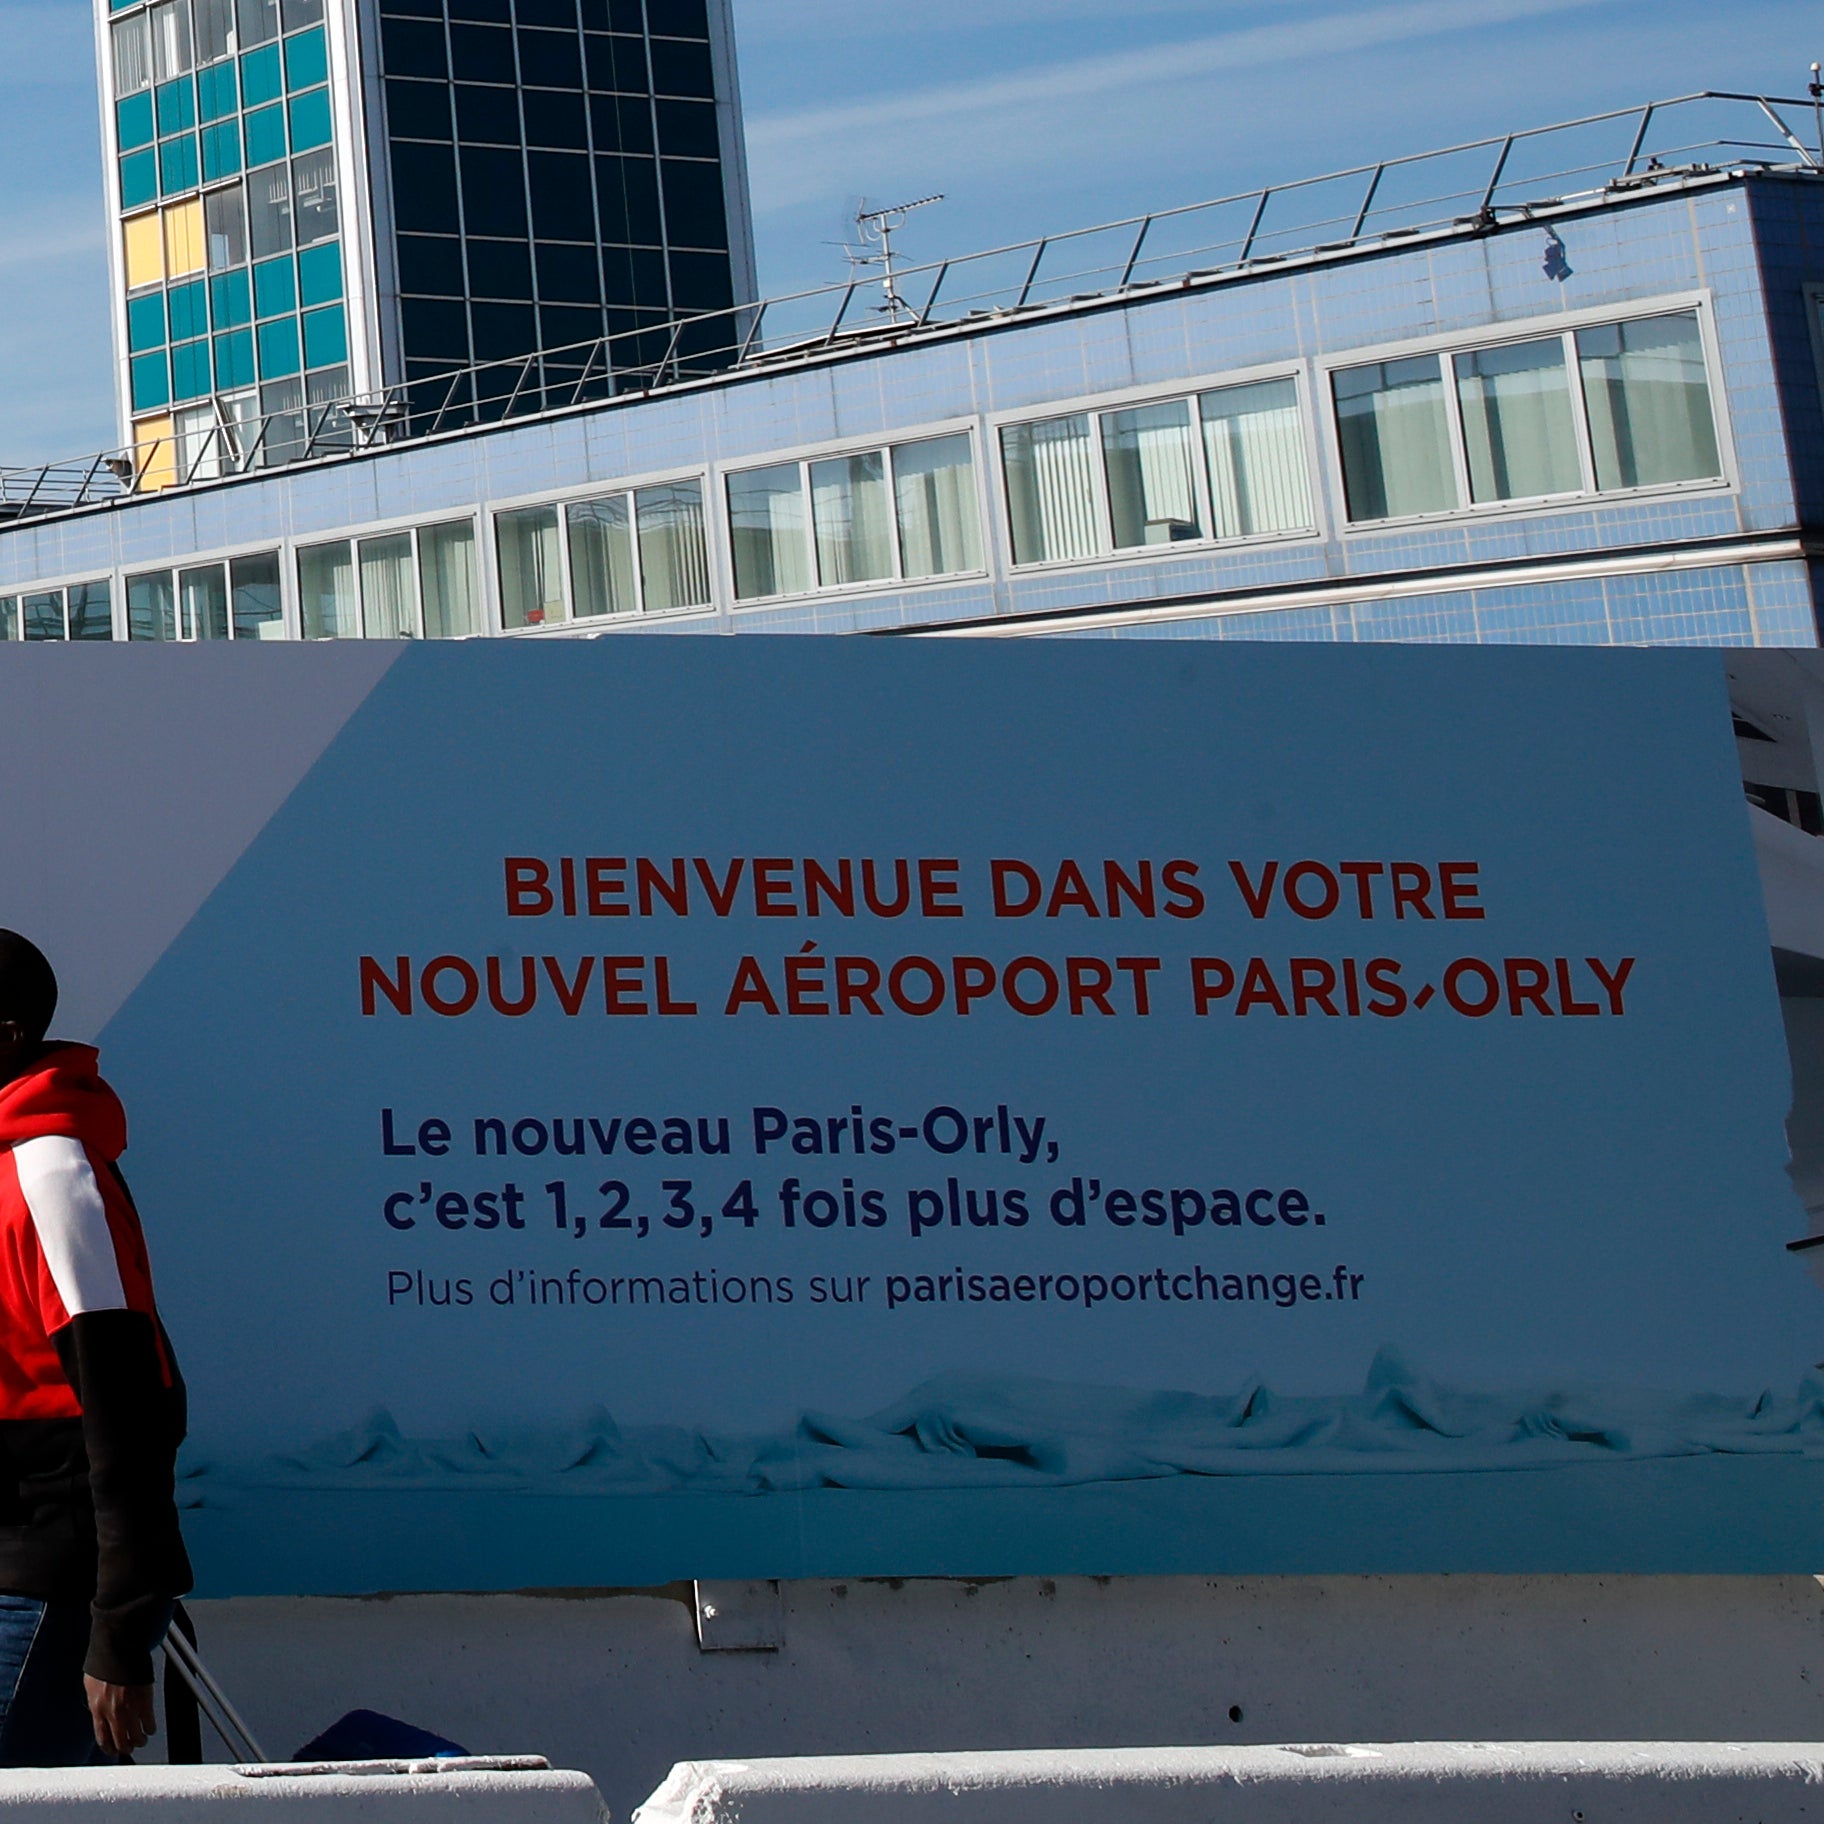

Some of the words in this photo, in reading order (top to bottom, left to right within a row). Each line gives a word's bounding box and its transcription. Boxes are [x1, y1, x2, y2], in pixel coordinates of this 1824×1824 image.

[505, 857, 964, 918] BIENVENUE
[991, 859, 1205, 919] DANS
[1229, 860, 1485, 920] VOTRE
[360, 955, 698, 1017] NOUVEL
[726, 941, 1161, 1017] AÉROPORT
[381, 1107, 452, 1157] Le
[473, 1117, 731, 1156] nouveau
[752, 1104, 1059, 1164] Paris-Orly,
[383, 1181, 526, 1231] c’est
[778, 1177, 888, 1228] fois
[907, 1177, 1030, 1238] plus
[1049, 1176, 1326, 1237] d’espace.
[387, 1269, 474, 1306] Plus
[489, 1268, 794, 1306] d’informations
[809, 1276, 871, 1304] sur
[885, 1264, 1365, 1310] parisaeroportchange.fr
